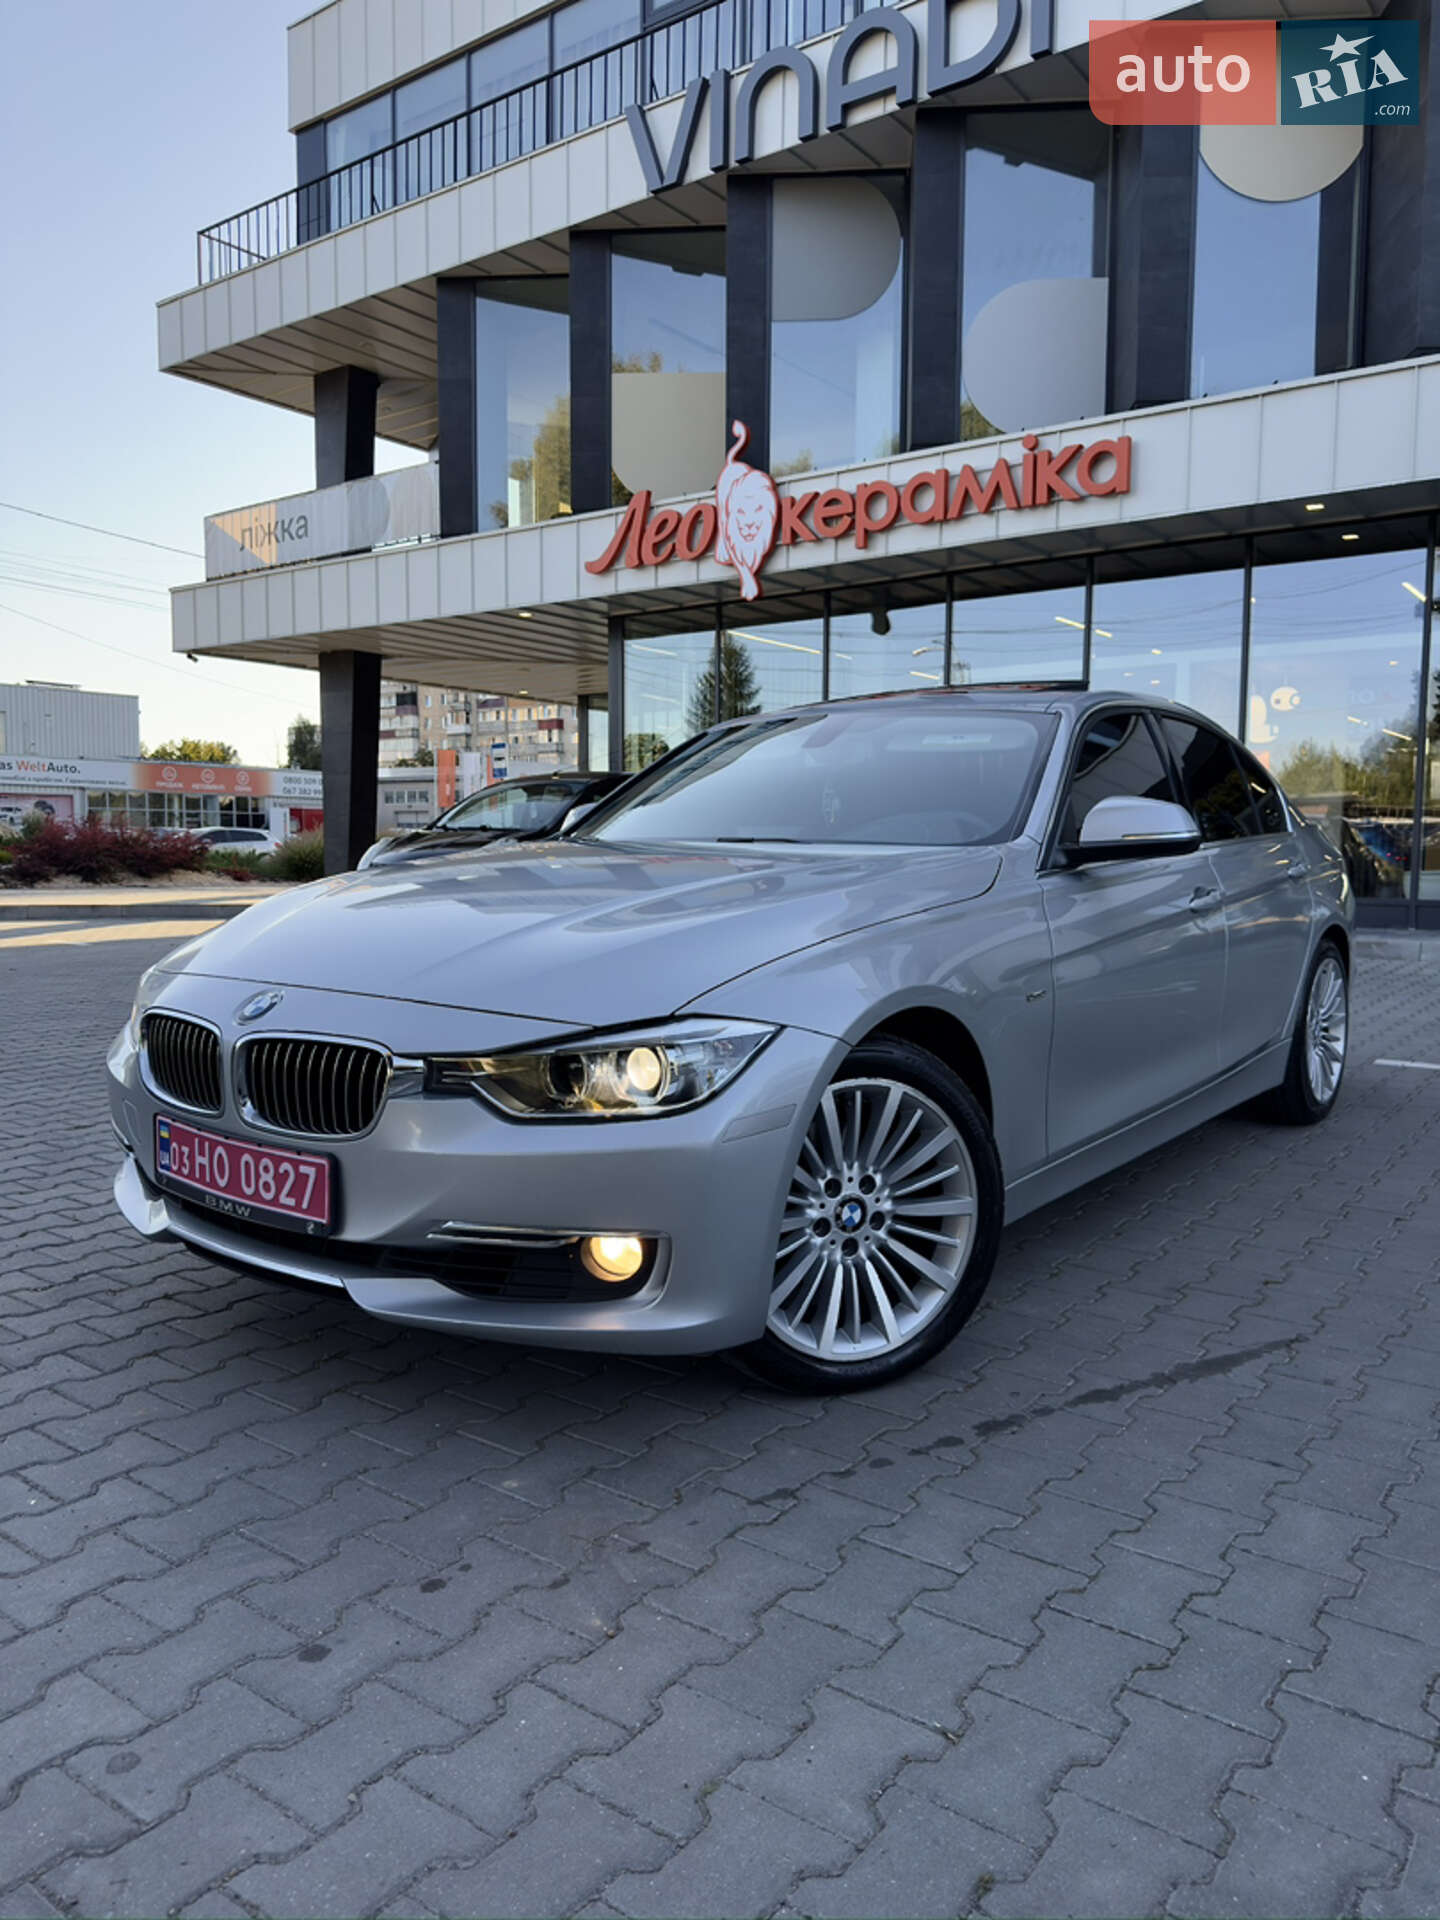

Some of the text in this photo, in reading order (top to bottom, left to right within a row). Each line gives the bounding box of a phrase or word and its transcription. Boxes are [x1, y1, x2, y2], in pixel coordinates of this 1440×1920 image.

[585, 435, 1132, 574] Лео кераміка
[240, 514, 309, 552] ліжка
[240, 1153, 317, 1210] 0827
[205, 1195, 251, 1217] BMW
